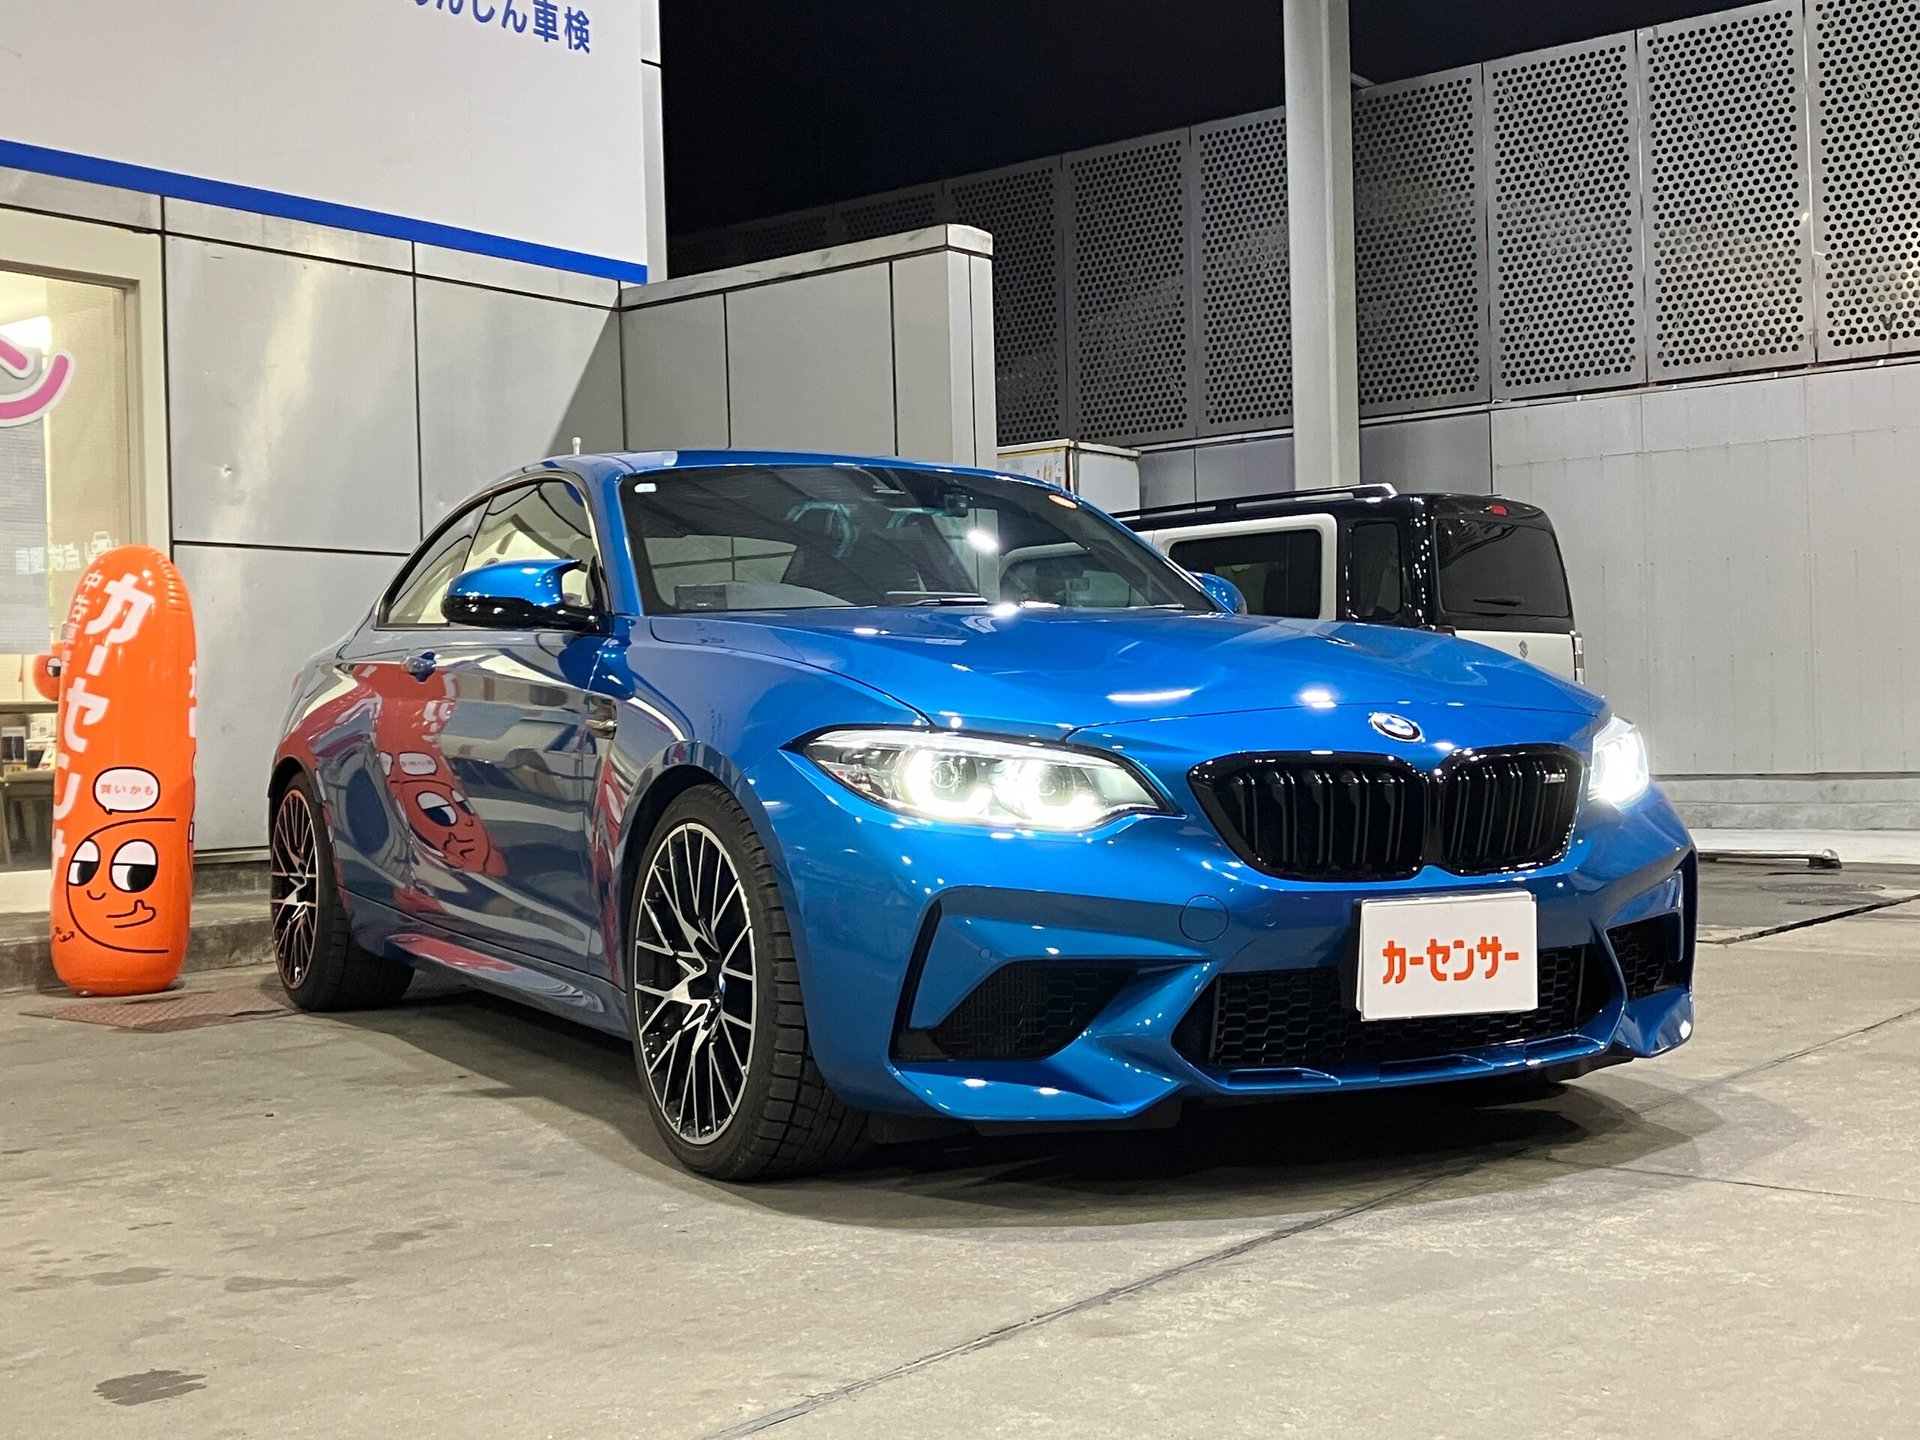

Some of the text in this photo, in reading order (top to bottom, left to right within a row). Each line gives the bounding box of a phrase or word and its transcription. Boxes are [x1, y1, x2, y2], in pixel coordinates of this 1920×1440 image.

[414, 0, 590, 53] しん車検
[100, 784, 154, 796] 買いかも
[1382, 936, 1519, 984] カーセンサー
